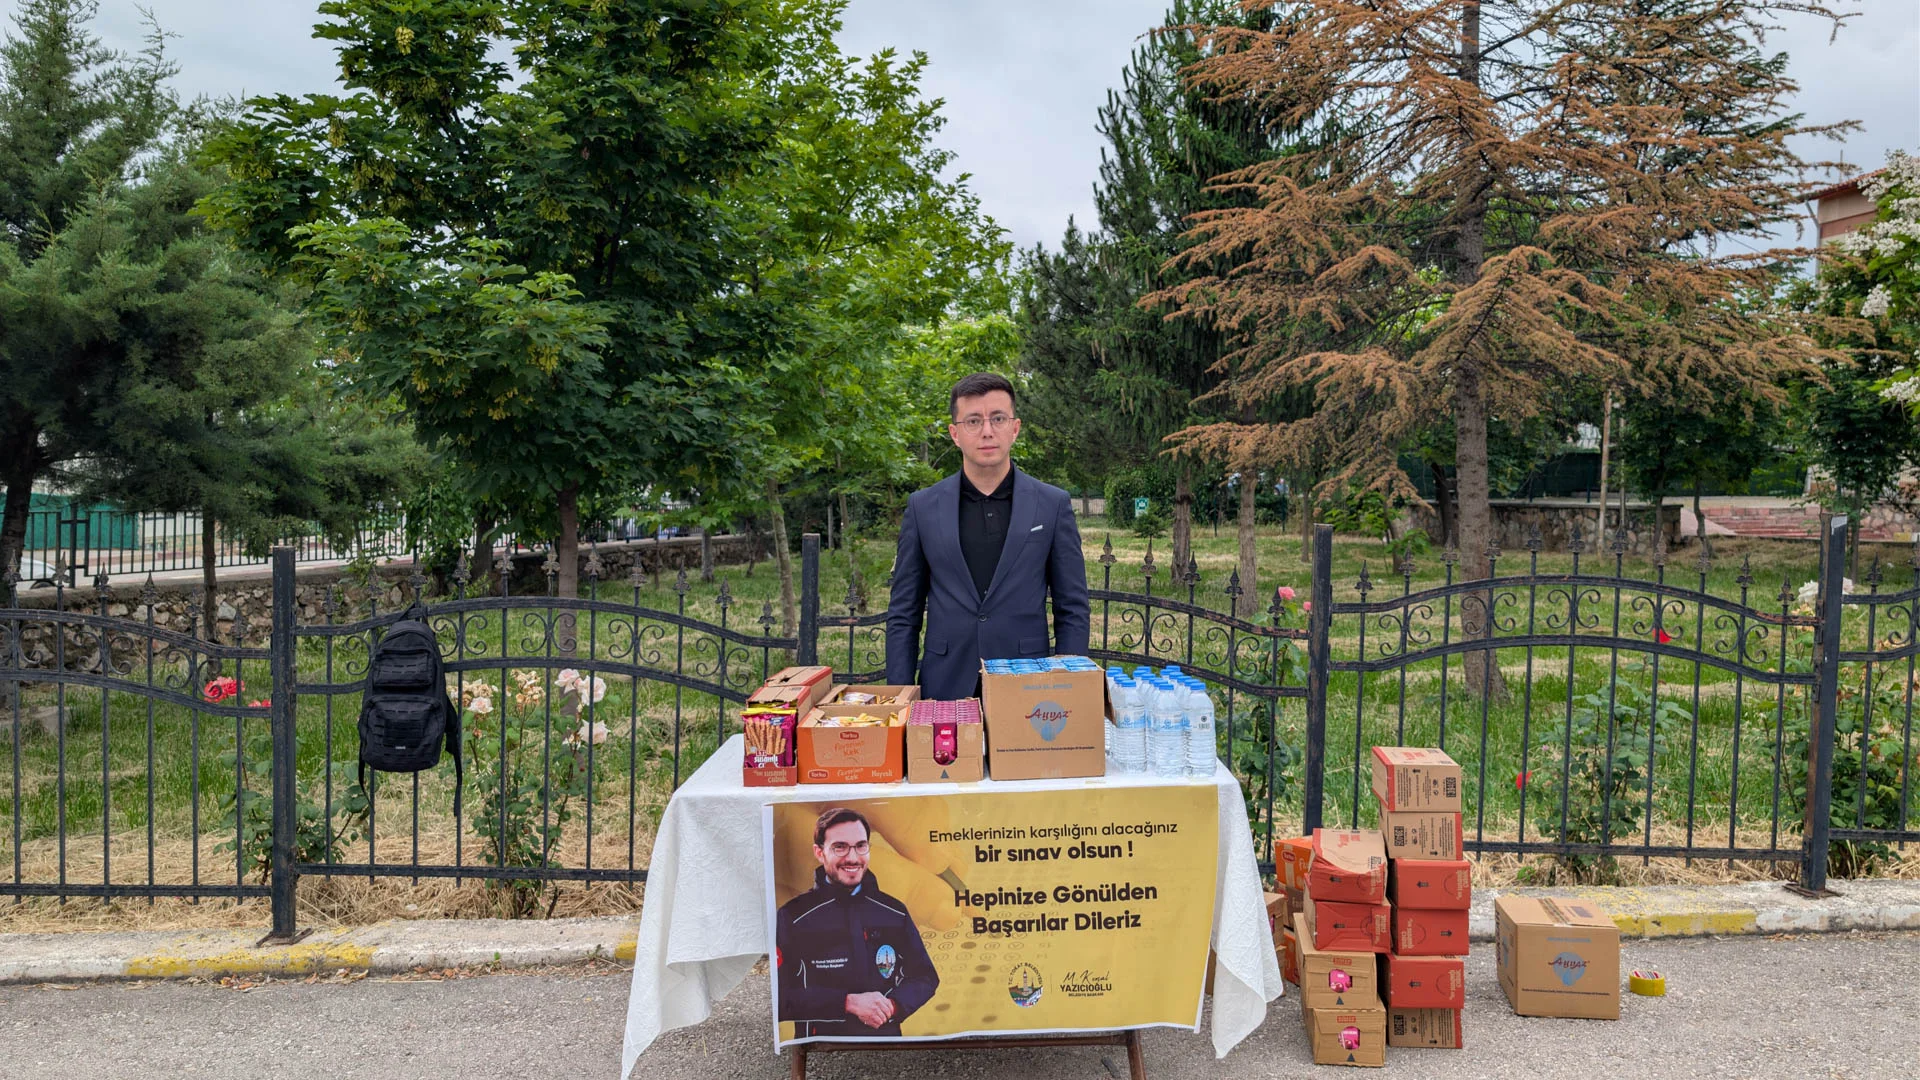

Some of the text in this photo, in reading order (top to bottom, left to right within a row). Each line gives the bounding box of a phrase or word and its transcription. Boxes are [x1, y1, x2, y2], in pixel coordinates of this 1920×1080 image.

[929, 822, 1178, 843] Emeklerinizin karşılığını alacağınız
[975, 841, 1134, 863] bir sınav olsun !
[954, 882, 1158, 911] Hepinize Gönülden
[973, 910, 1142, 938] Başarılar Dileriz
[1060, 983, 1112, 992] YAZICIOĞLU
